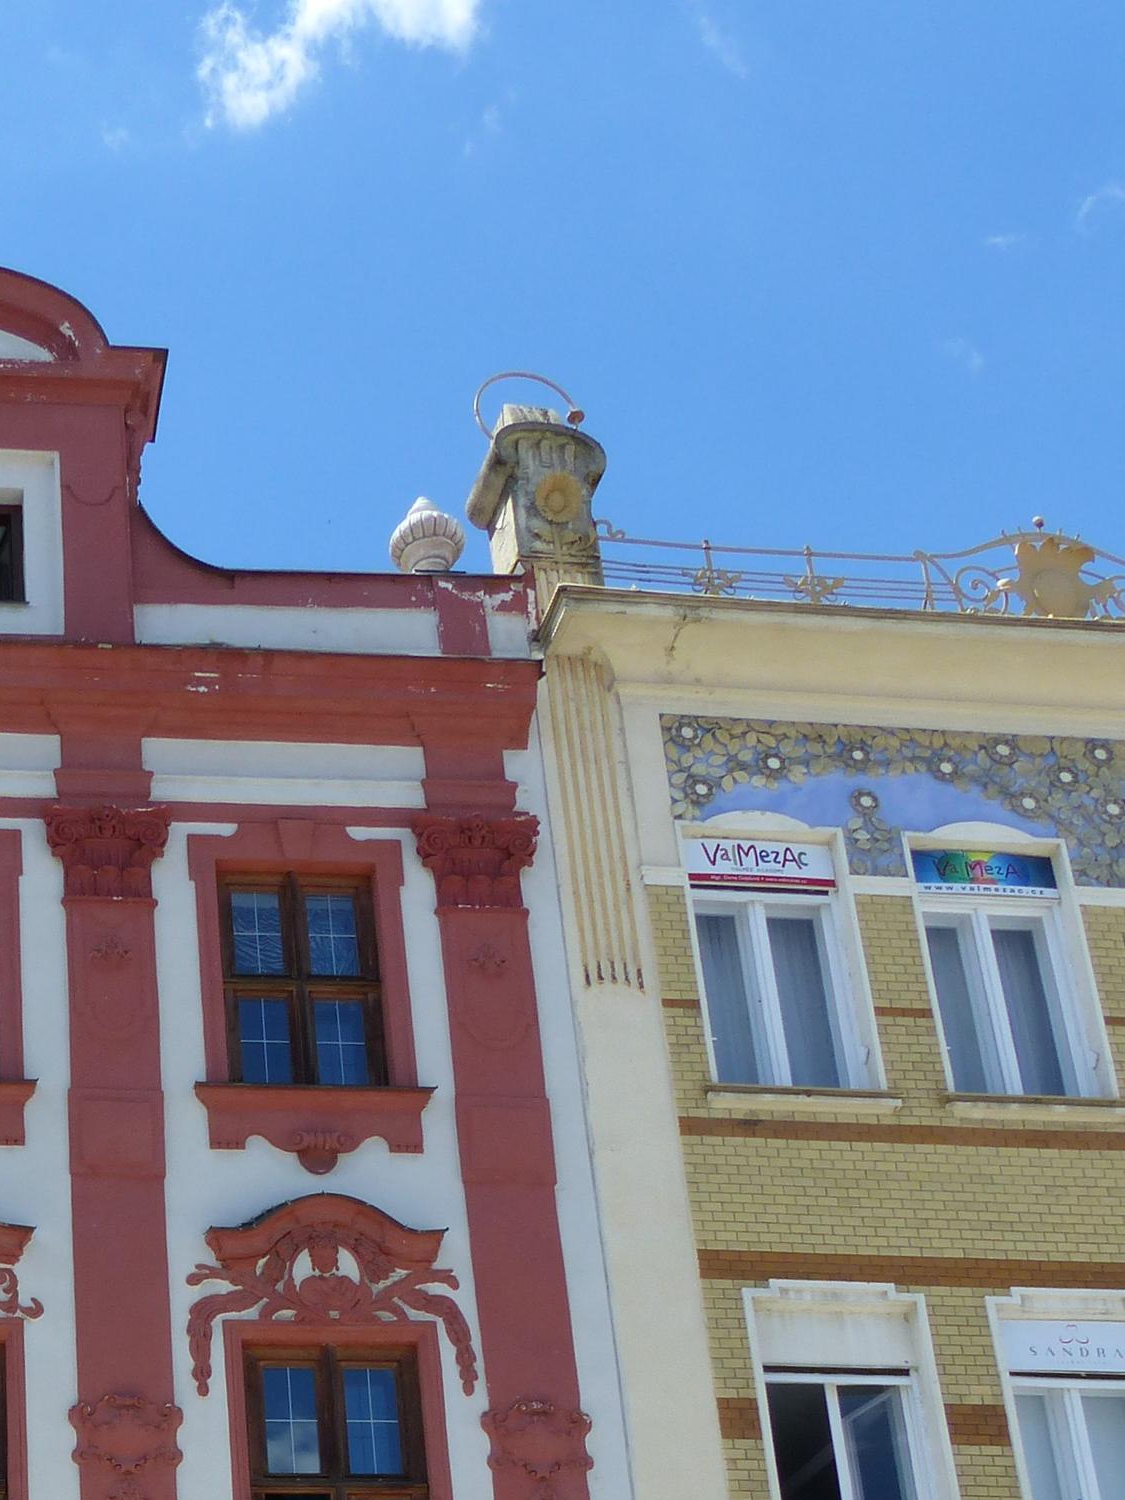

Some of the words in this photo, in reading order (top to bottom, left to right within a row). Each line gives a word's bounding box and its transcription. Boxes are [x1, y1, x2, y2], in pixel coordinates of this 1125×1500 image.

[701, 842, 809, 869] ValMezAc
[924, 885, 1044, 895] www.valmezac.cz
[1029, 1346, 1125, 1359] SANDRA
